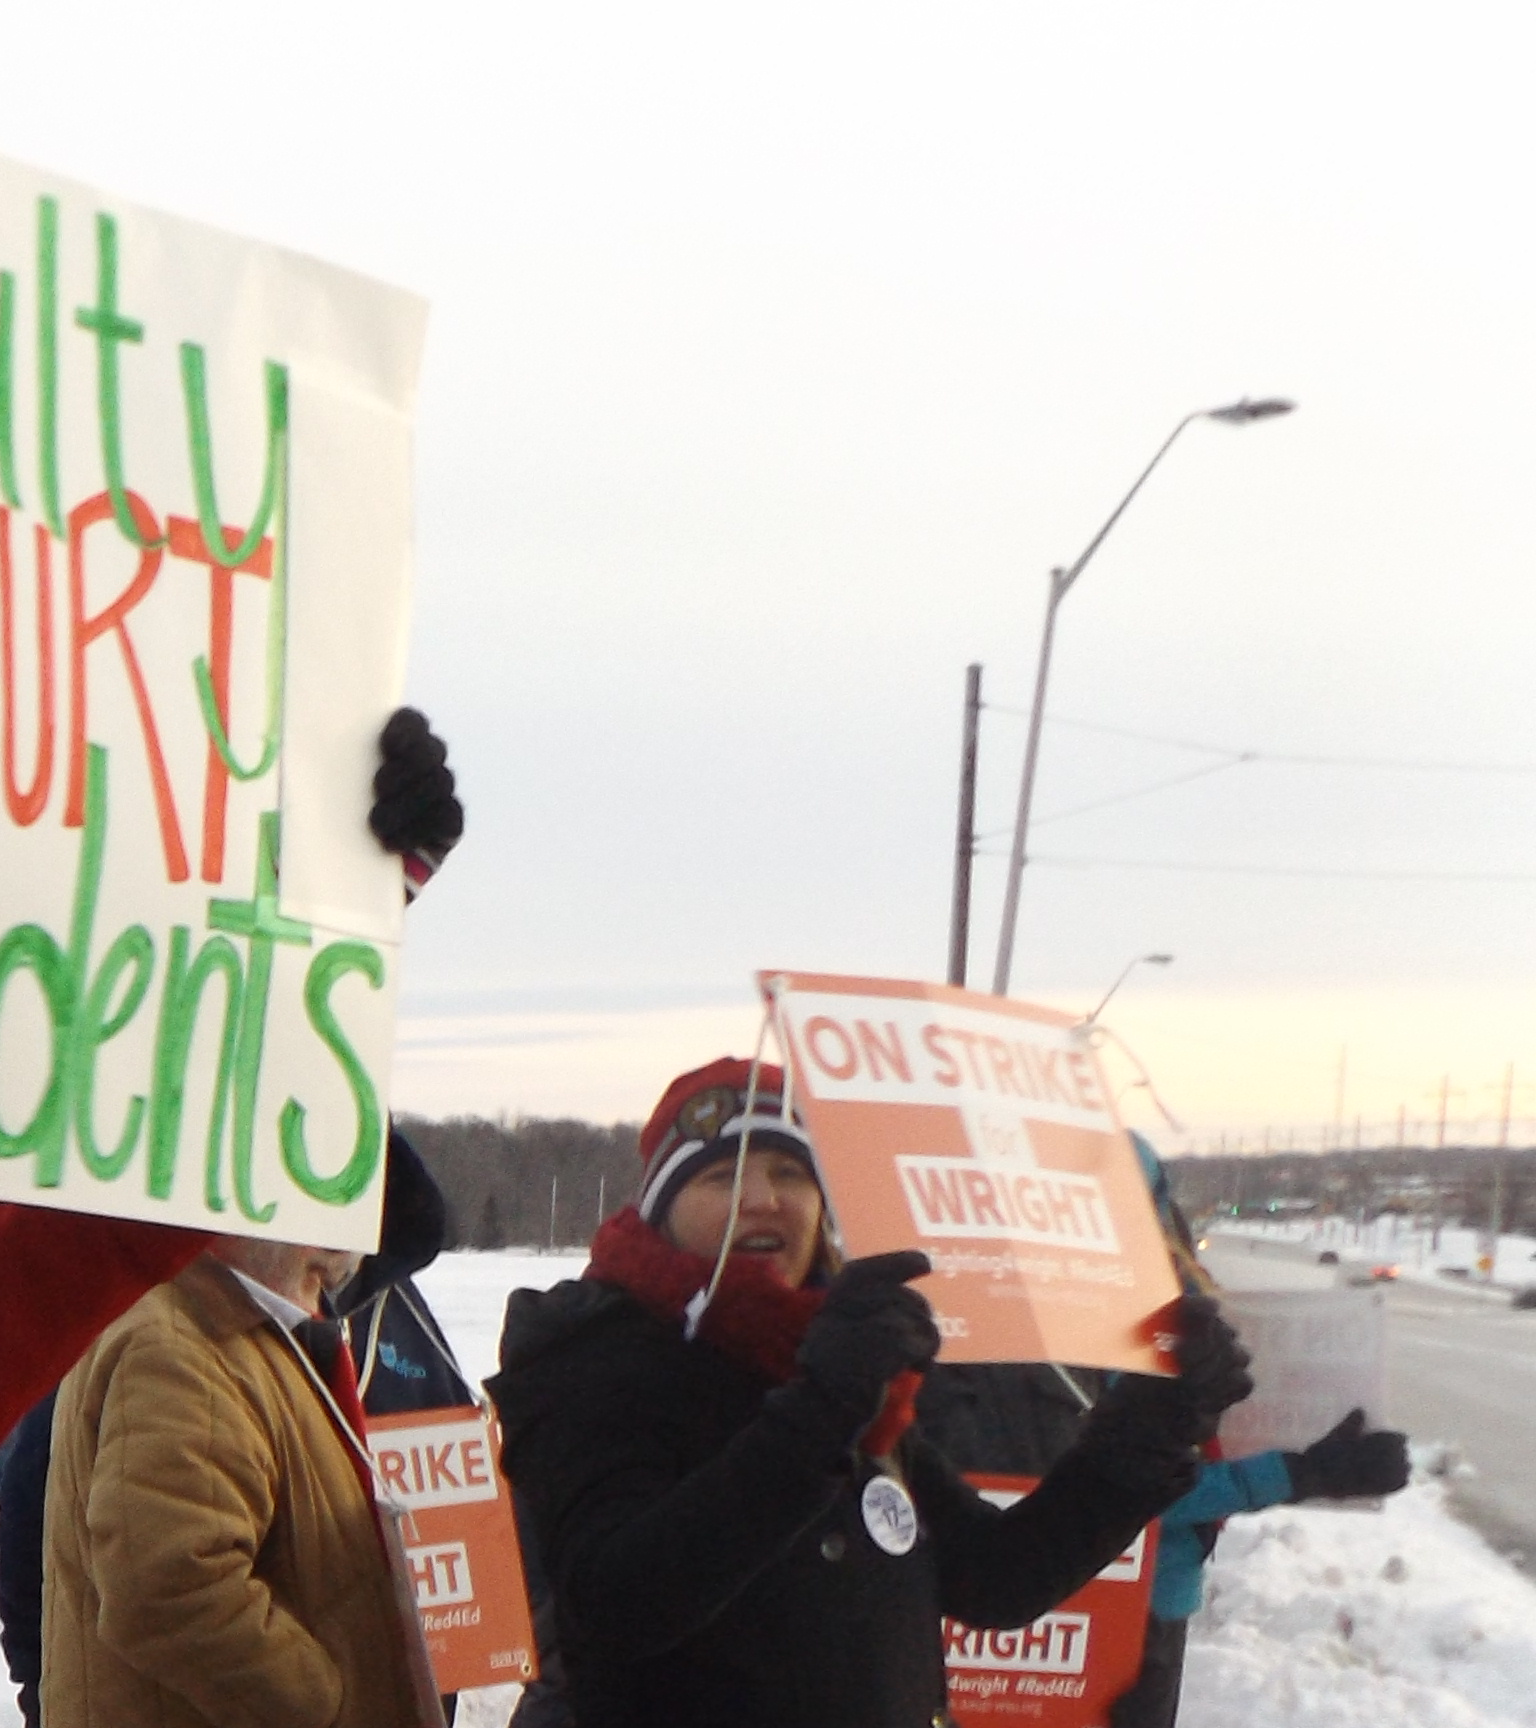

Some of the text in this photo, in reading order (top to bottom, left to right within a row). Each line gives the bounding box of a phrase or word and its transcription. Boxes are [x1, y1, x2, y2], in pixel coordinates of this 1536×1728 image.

[802, 1015, 1108, 1113] ON STRIKE
[905, 1164, 1106, 1242] WRIGHT
